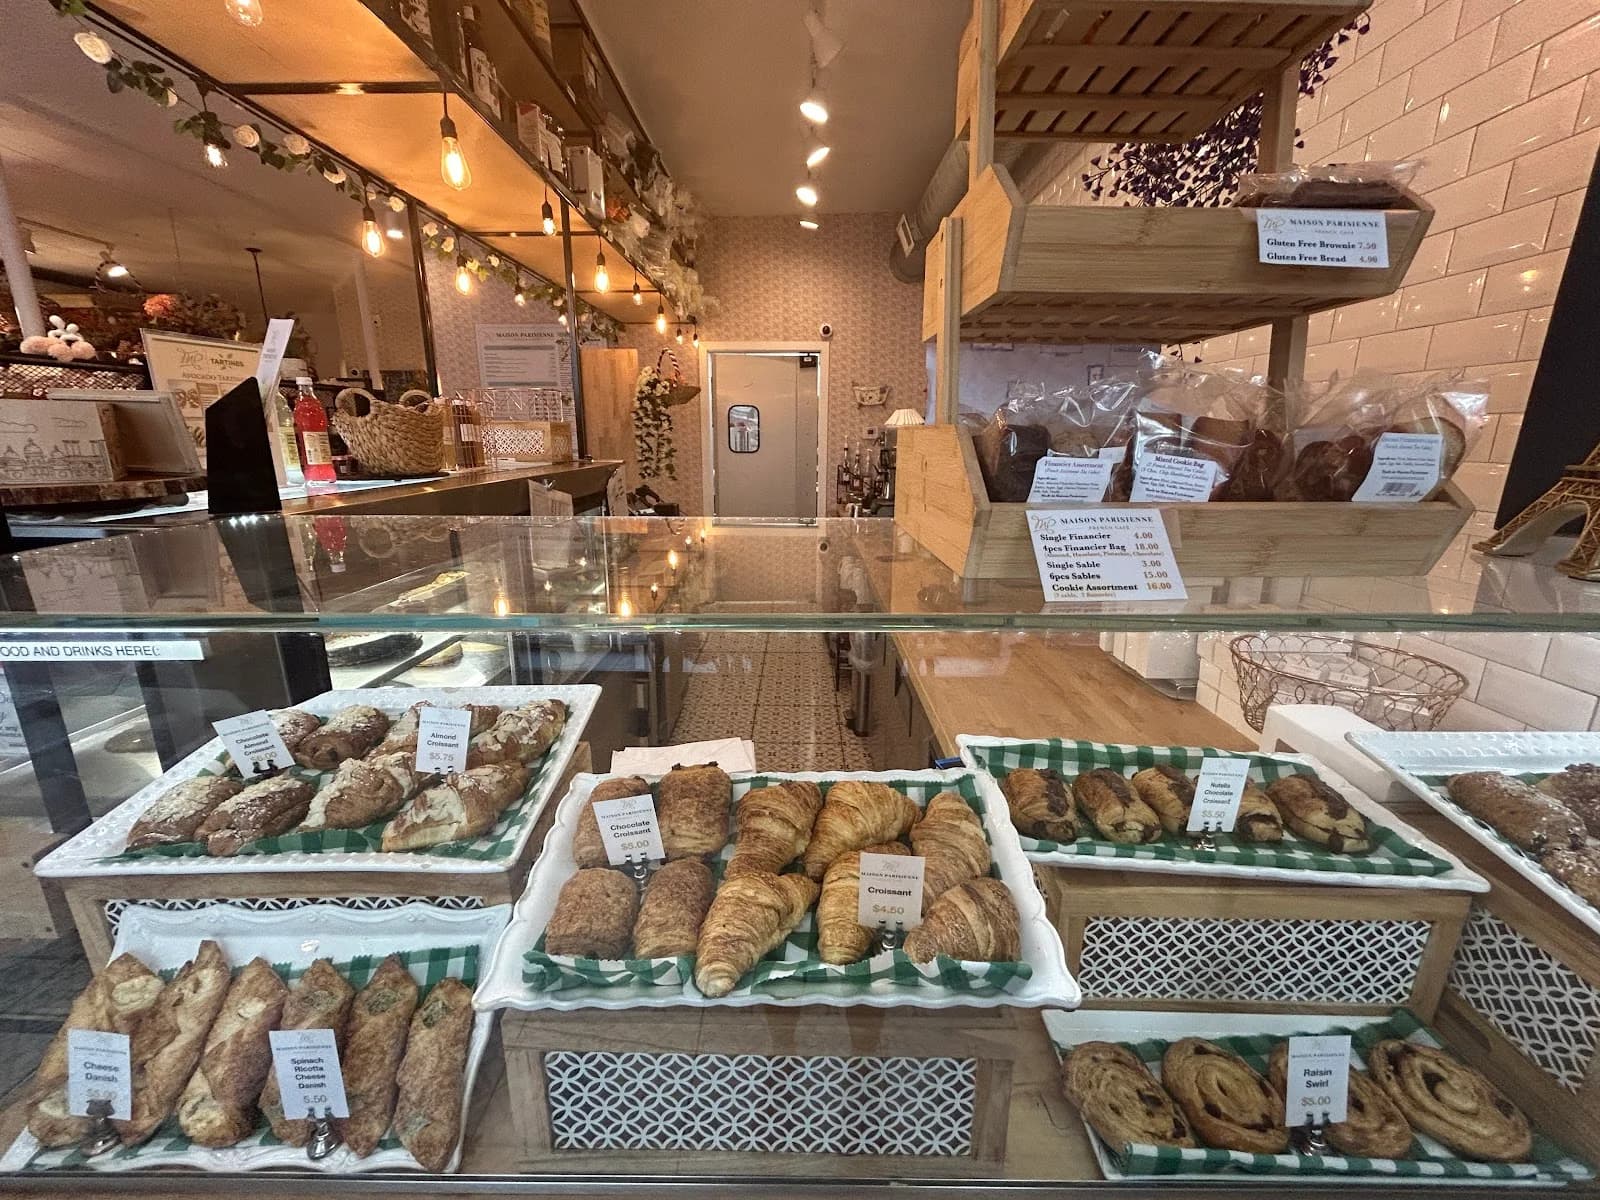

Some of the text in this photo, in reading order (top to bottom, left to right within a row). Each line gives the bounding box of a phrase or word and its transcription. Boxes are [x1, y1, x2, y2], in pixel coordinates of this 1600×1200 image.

[1289, 219, 1379, 227] MAISON PARISIENNE
[1267, 238, 1376, 250] Gluten Free Brownie 7.50
[1267, 252, 1296, 261] Gluten
[210, 358, 244, 367] TARTINES
[1155, 456, 1172, 464] Mixed
[1040, 534, 1067, 542] Single
[1046, 561, 1074, 570] Single
[1050, 573, 1070, 581] 6pcs
[1147, 582, 1172, 590] 16.00
[34, 646, 60, 656] AND
[64, 646, 113, 656] DRINKS
[235, 733, 268, 744] Chocolate
[431, 732, 456, 740] Almond
[244, 739, 268, 749] Almond
[427, 740, 459, 748] Croissant
[244, 744, 276, 756] Croissant
[610, 820, 650, 831] Chocolate
[613, 828, 651, 838] Croissant
[621, 840, 649, 850] $5.00
[868, 886, 912, 897] Croissant
[872, 904, 904, 914] $4.50
[83, 1061, 120, 1073] Cheese
[1303, 1068, 1332, 1077] Raisin
[85, 1072, 118, 1083] Danish
[1306, 1080, 1329, 1088] Swirl
[303, 1095, 328, 1104] 5.50
[1301, 1096, 1331, 1107] $5.00
